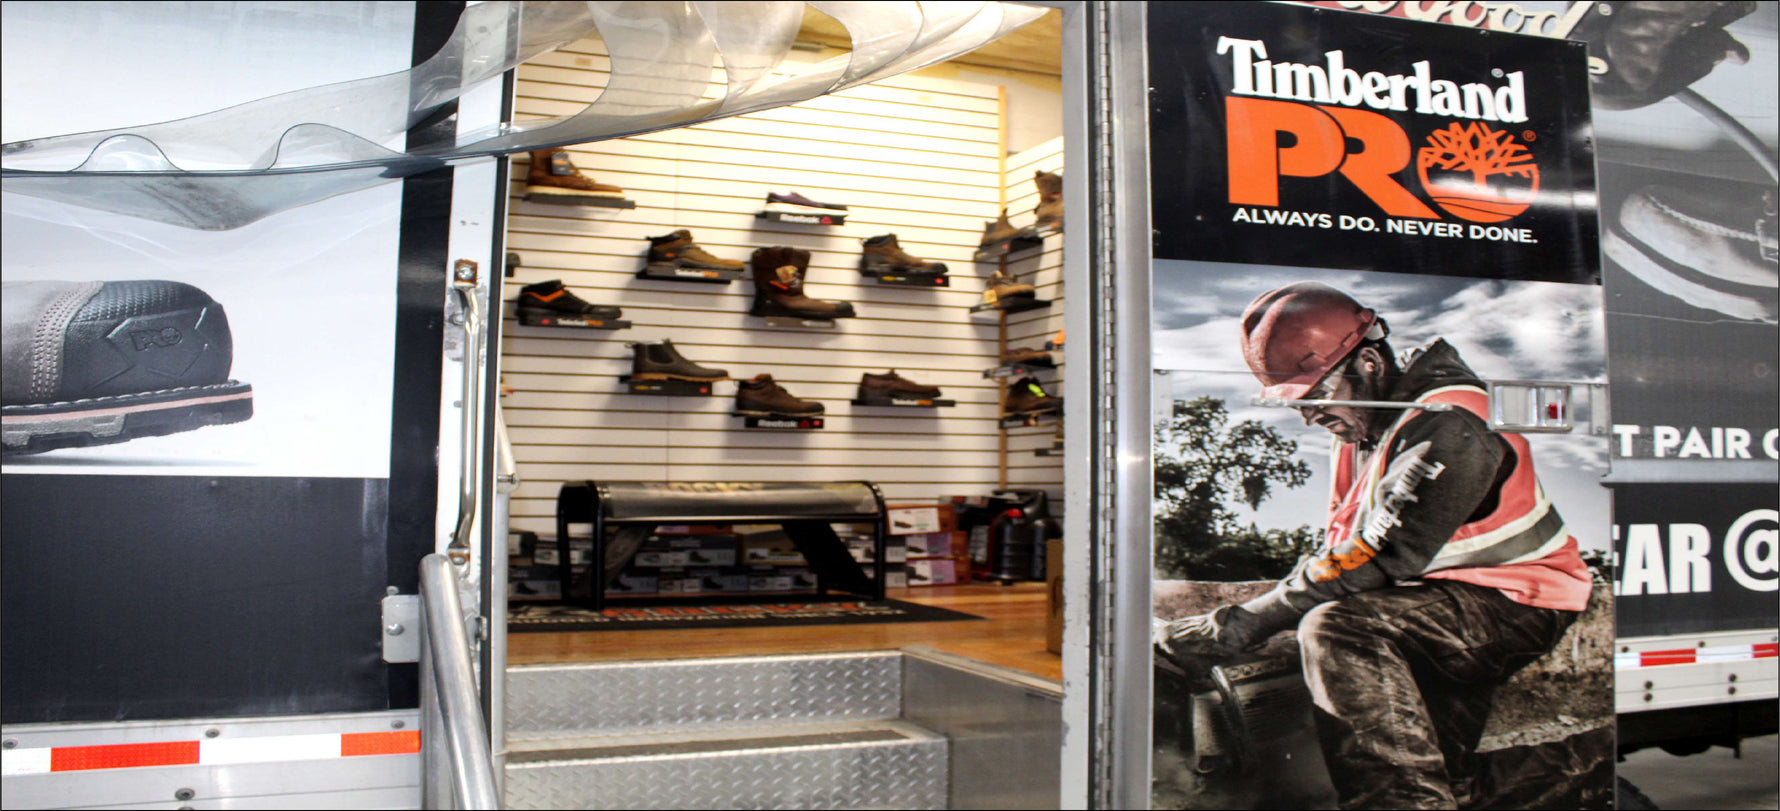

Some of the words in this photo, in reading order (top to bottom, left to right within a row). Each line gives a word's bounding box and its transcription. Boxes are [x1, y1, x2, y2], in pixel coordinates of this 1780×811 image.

[1216, 36, 1529, 123] Timberland
[1225, 96, 1540, 223] PRO
[1232, 207, 1333, 229] ALWAYS
[1338, 214, 1380, 232] DO.
[1386, 218, 1464, 238] NEVER
[1469, 224, 1538, 244] DONE.
[1653, 425, 1752, 459] PAIR
[1612, 523, 1712, 596] AR
